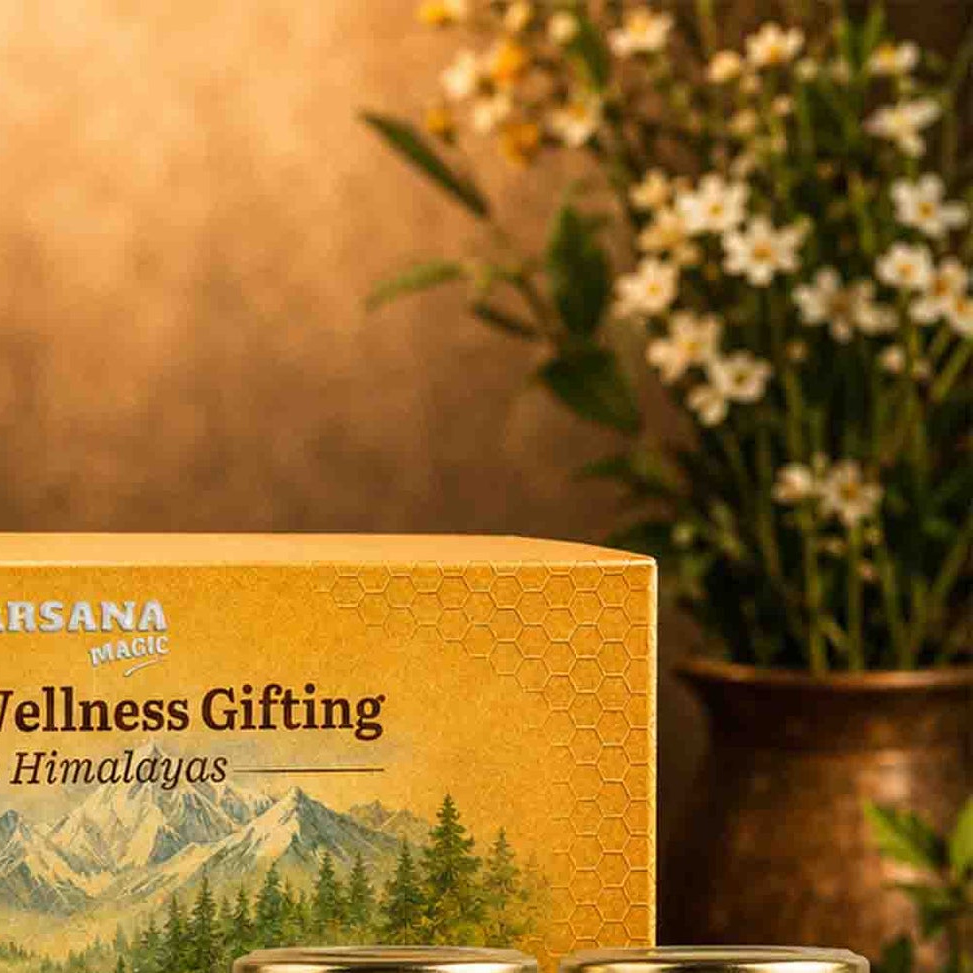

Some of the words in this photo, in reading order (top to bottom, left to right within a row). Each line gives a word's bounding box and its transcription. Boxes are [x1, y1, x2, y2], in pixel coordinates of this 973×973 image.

[88, 635, 170, 667] MAGIC
[201, 684, 385, 741] Gifting
[12, 750, 228, 791] Himalayas
